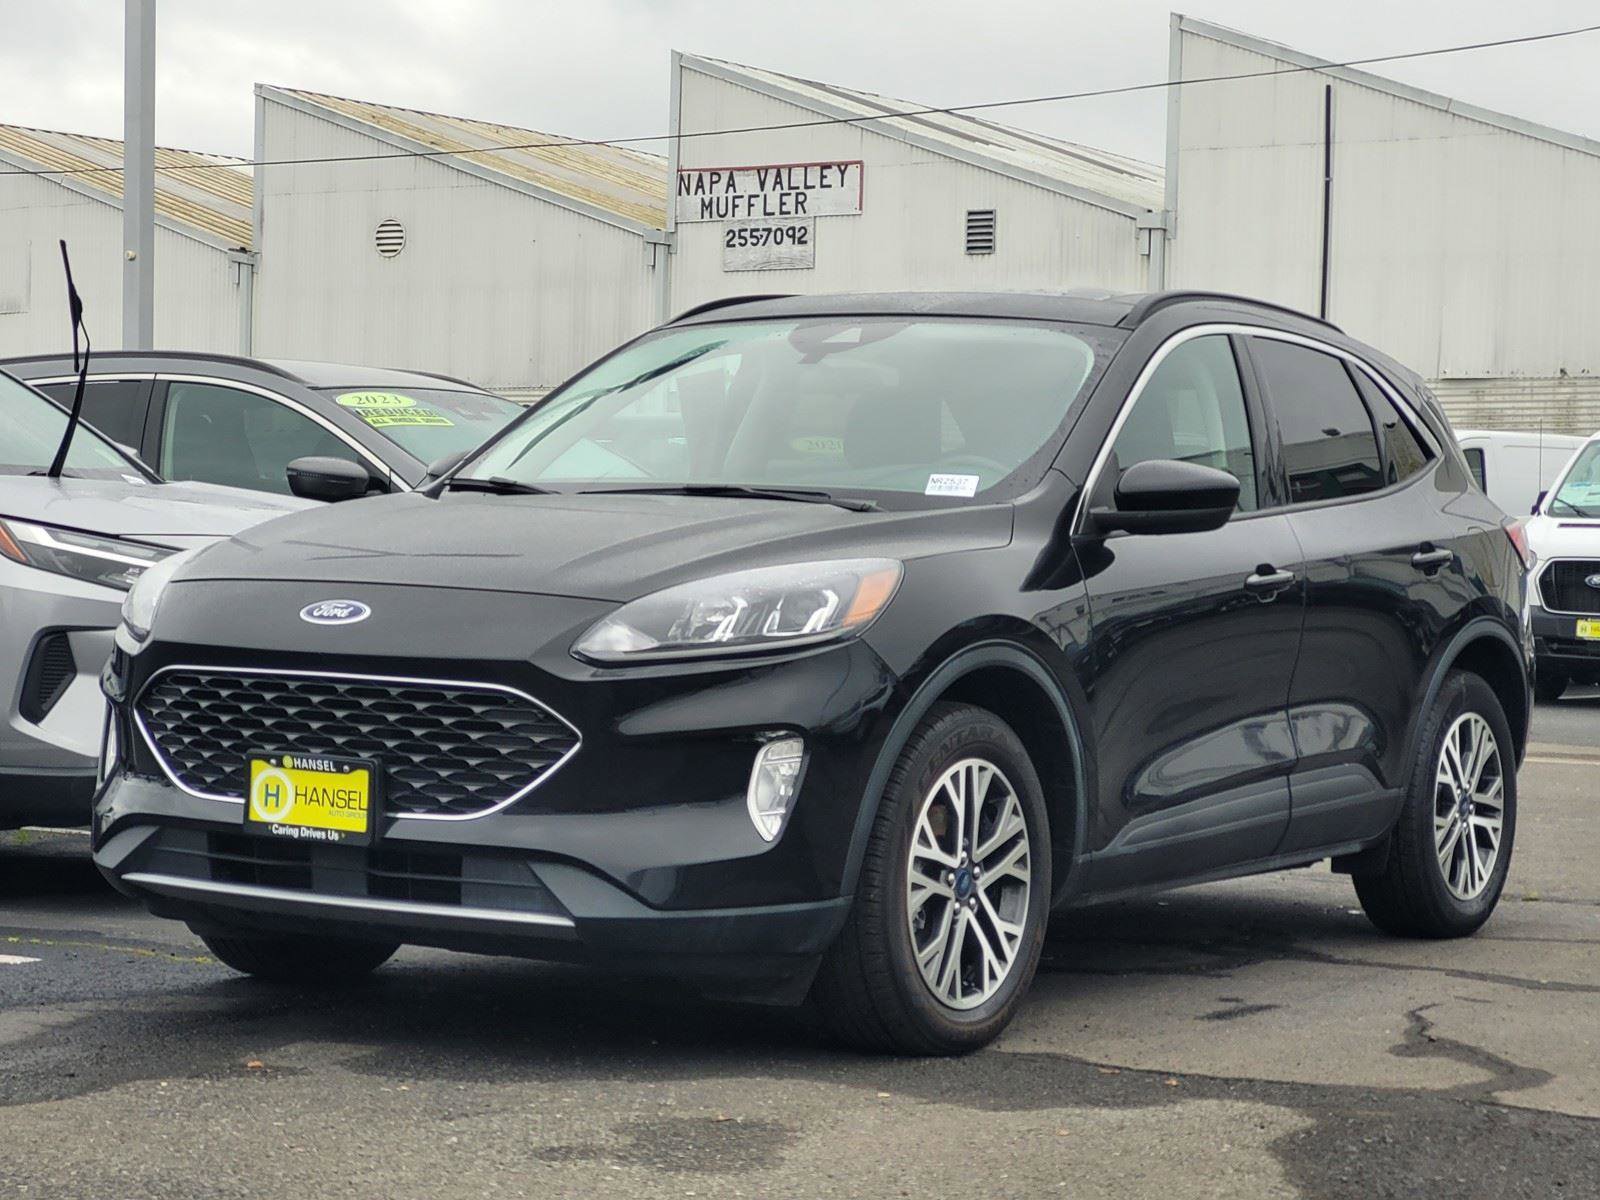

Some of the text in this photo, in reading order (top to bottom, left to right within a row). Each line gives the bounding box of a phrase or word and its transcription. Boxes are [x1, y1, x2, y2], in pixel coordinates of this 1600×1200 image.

[678, 164, 848, 196] NAPA VALLEY
[701, 192, 807, 219] MUFFLER
[293, 758, 337, 772] HANSEL
[264, 783, 280, 808] H
[294, 785, 367, 811] HANSEL
[272, 824, 339, 840] Caring Drives Us
